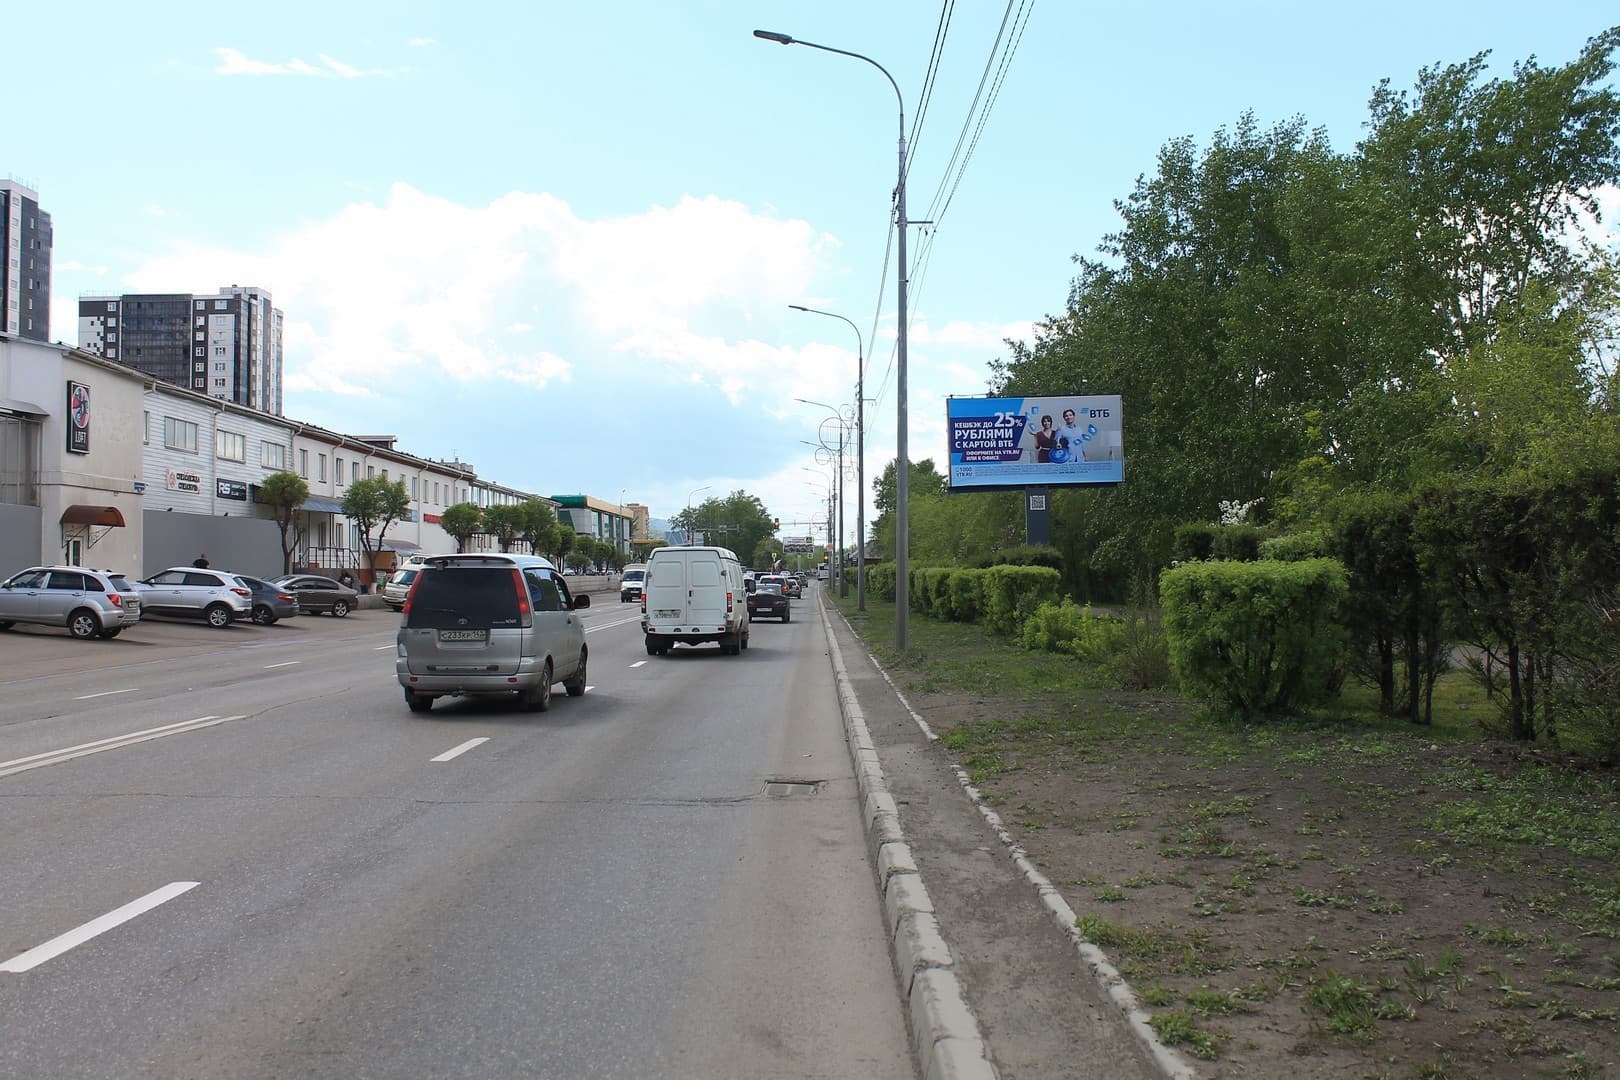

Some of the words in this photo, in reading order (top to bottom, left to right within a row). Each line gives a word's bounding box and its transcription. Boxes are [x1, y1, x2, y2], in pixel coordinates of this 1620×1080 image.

[1090, 409, 1109, 418] ВТБ
[954, 428, 1013, 440] РУБЛЯМИ
[962, 440, 996, 448] КАРТОЙ
